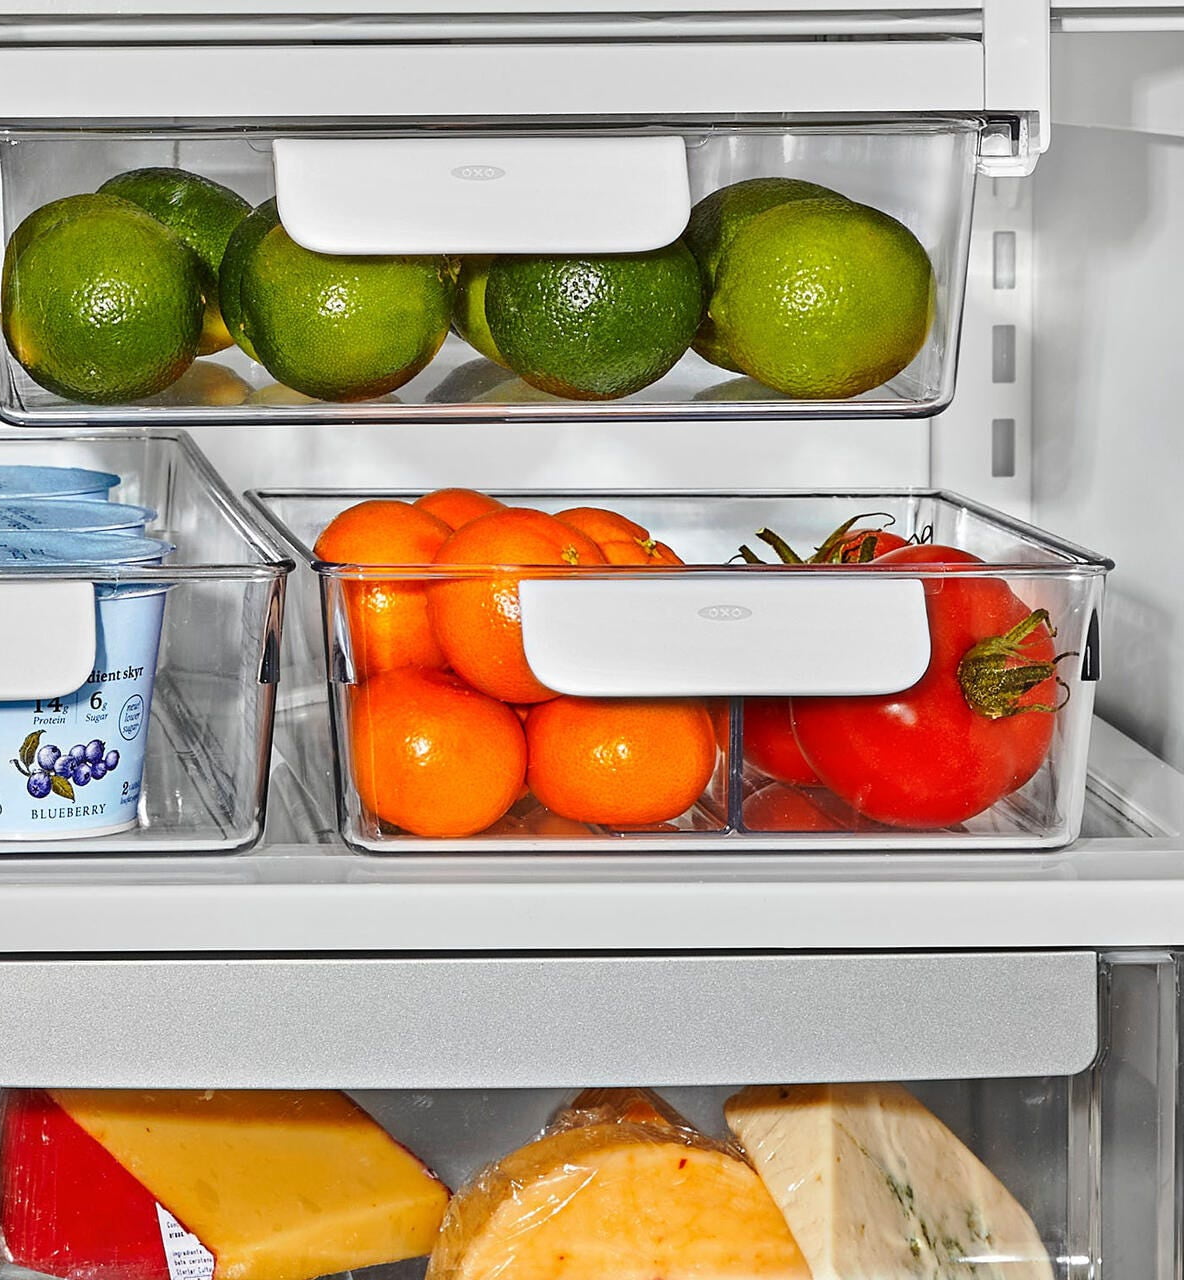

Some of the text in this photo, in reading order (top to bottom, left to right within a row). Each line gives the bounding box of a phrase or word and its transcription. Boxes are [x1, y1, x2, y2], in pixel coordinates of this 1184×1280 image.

[462, 168, 495, 178] OXO
[708, 607, 742, 618] OXO
[123, 666, 144, 681] skyr
[90, 691, 108, 711] 6g
[33, 713, 108, 725] Protein Sugar
[31, 804, 106, 820] BLUEBERRY
